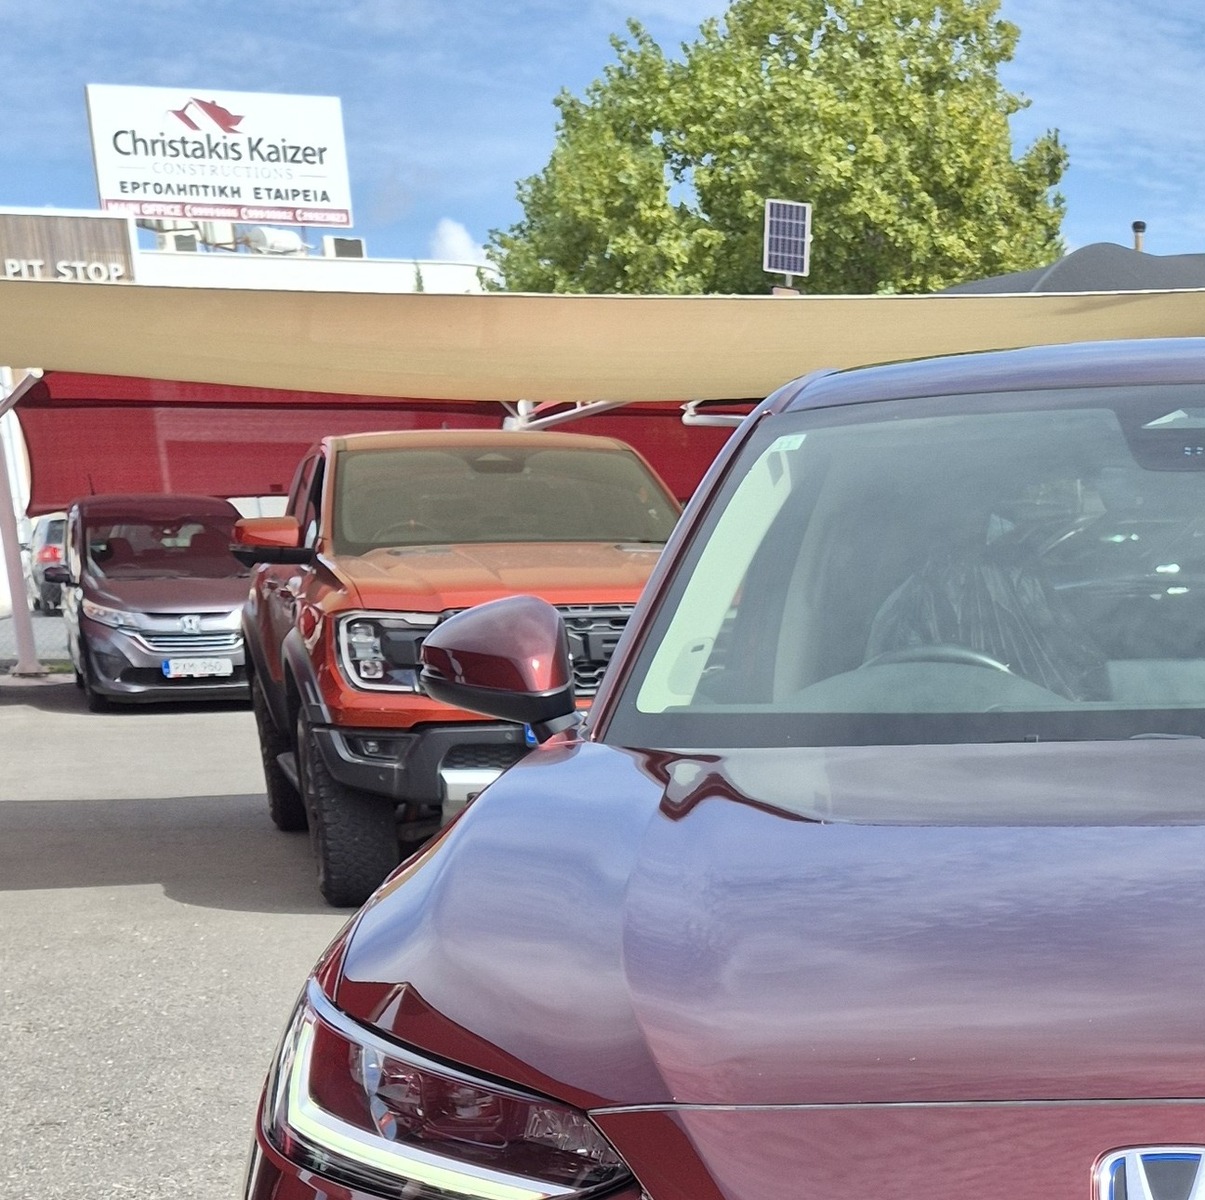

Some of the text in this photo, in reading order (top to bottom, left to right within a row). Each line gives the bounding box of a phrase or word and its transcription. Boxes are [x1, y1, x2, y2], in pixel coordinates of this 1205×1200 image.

[112, 129, 328, 165] Christakis Kaizer
[152, 161, 294, 180] CONSTRUCTIONS
[5, 258, 125, 282] PIT STOP
